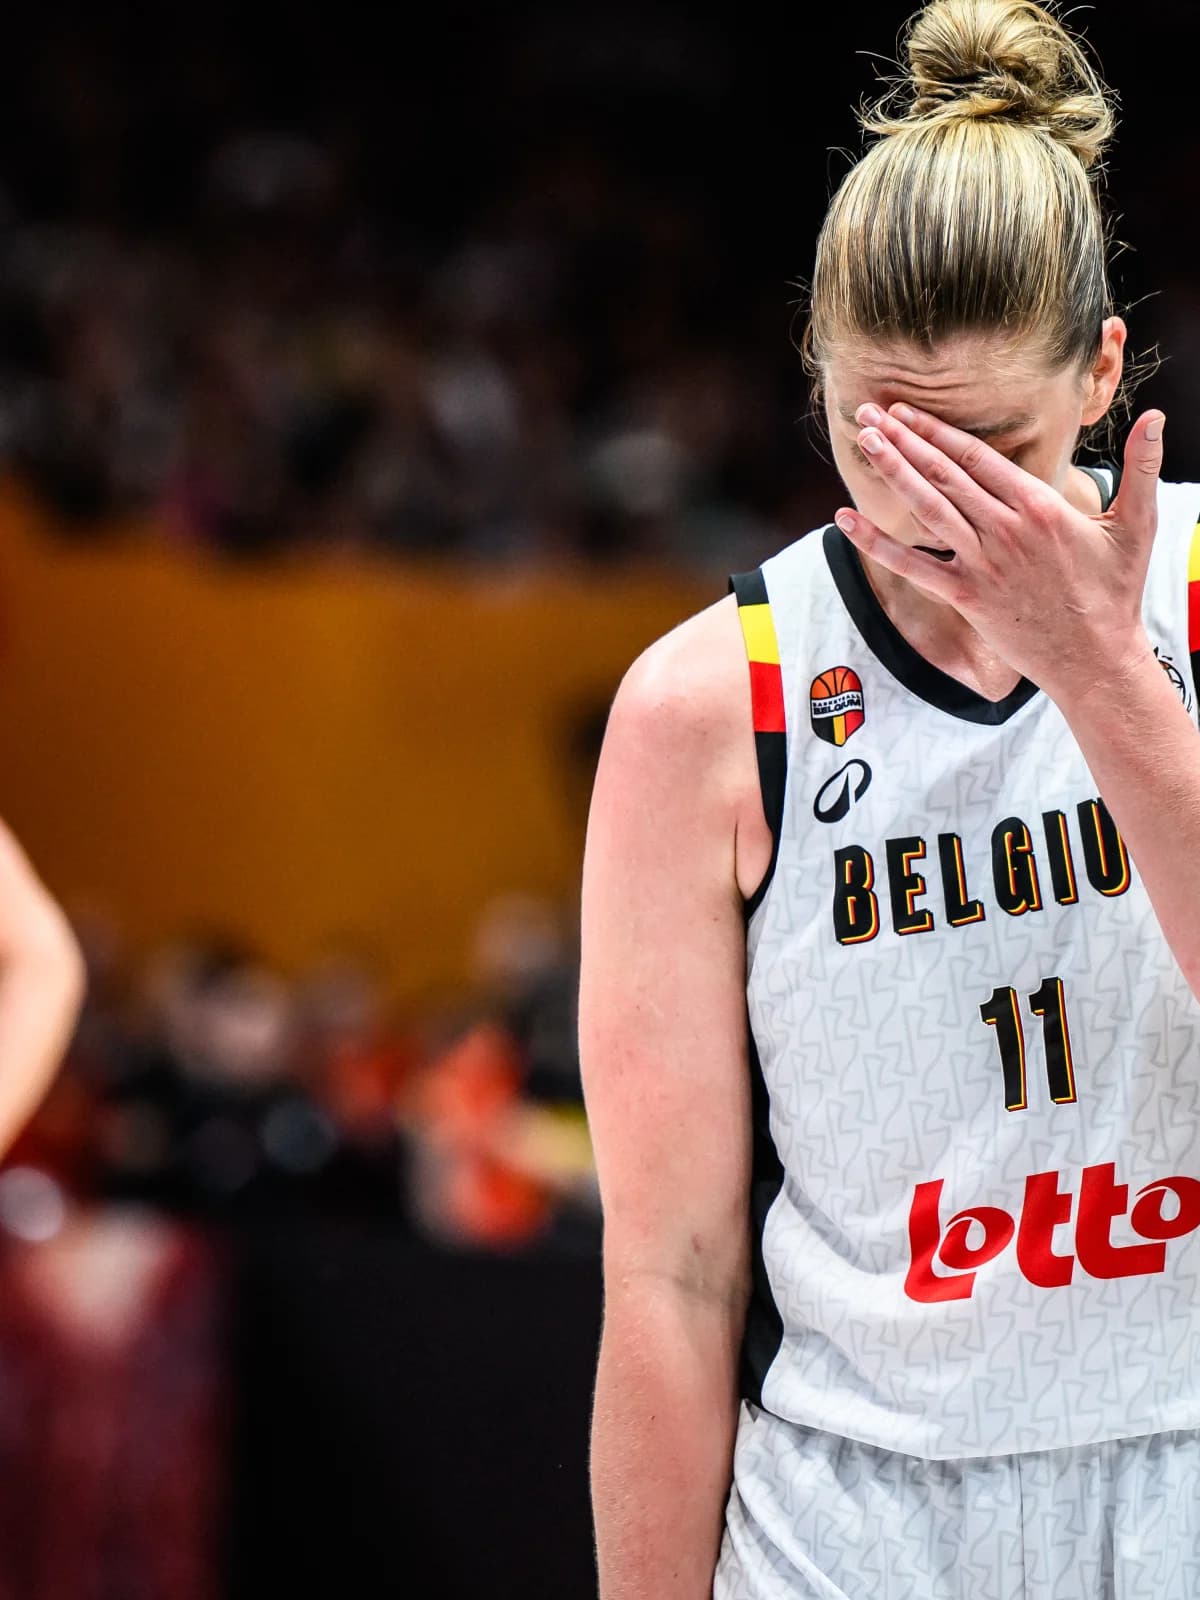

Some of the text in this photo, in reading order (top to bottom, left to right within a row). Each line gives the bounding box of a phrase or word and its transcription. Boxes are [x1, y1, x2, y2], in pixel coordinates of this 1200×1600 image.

[813, 699, 861, 715] BELGIUM
[833, 797, 1131, 946] BELGIU
[980, 976, 1077, 1112] 11
